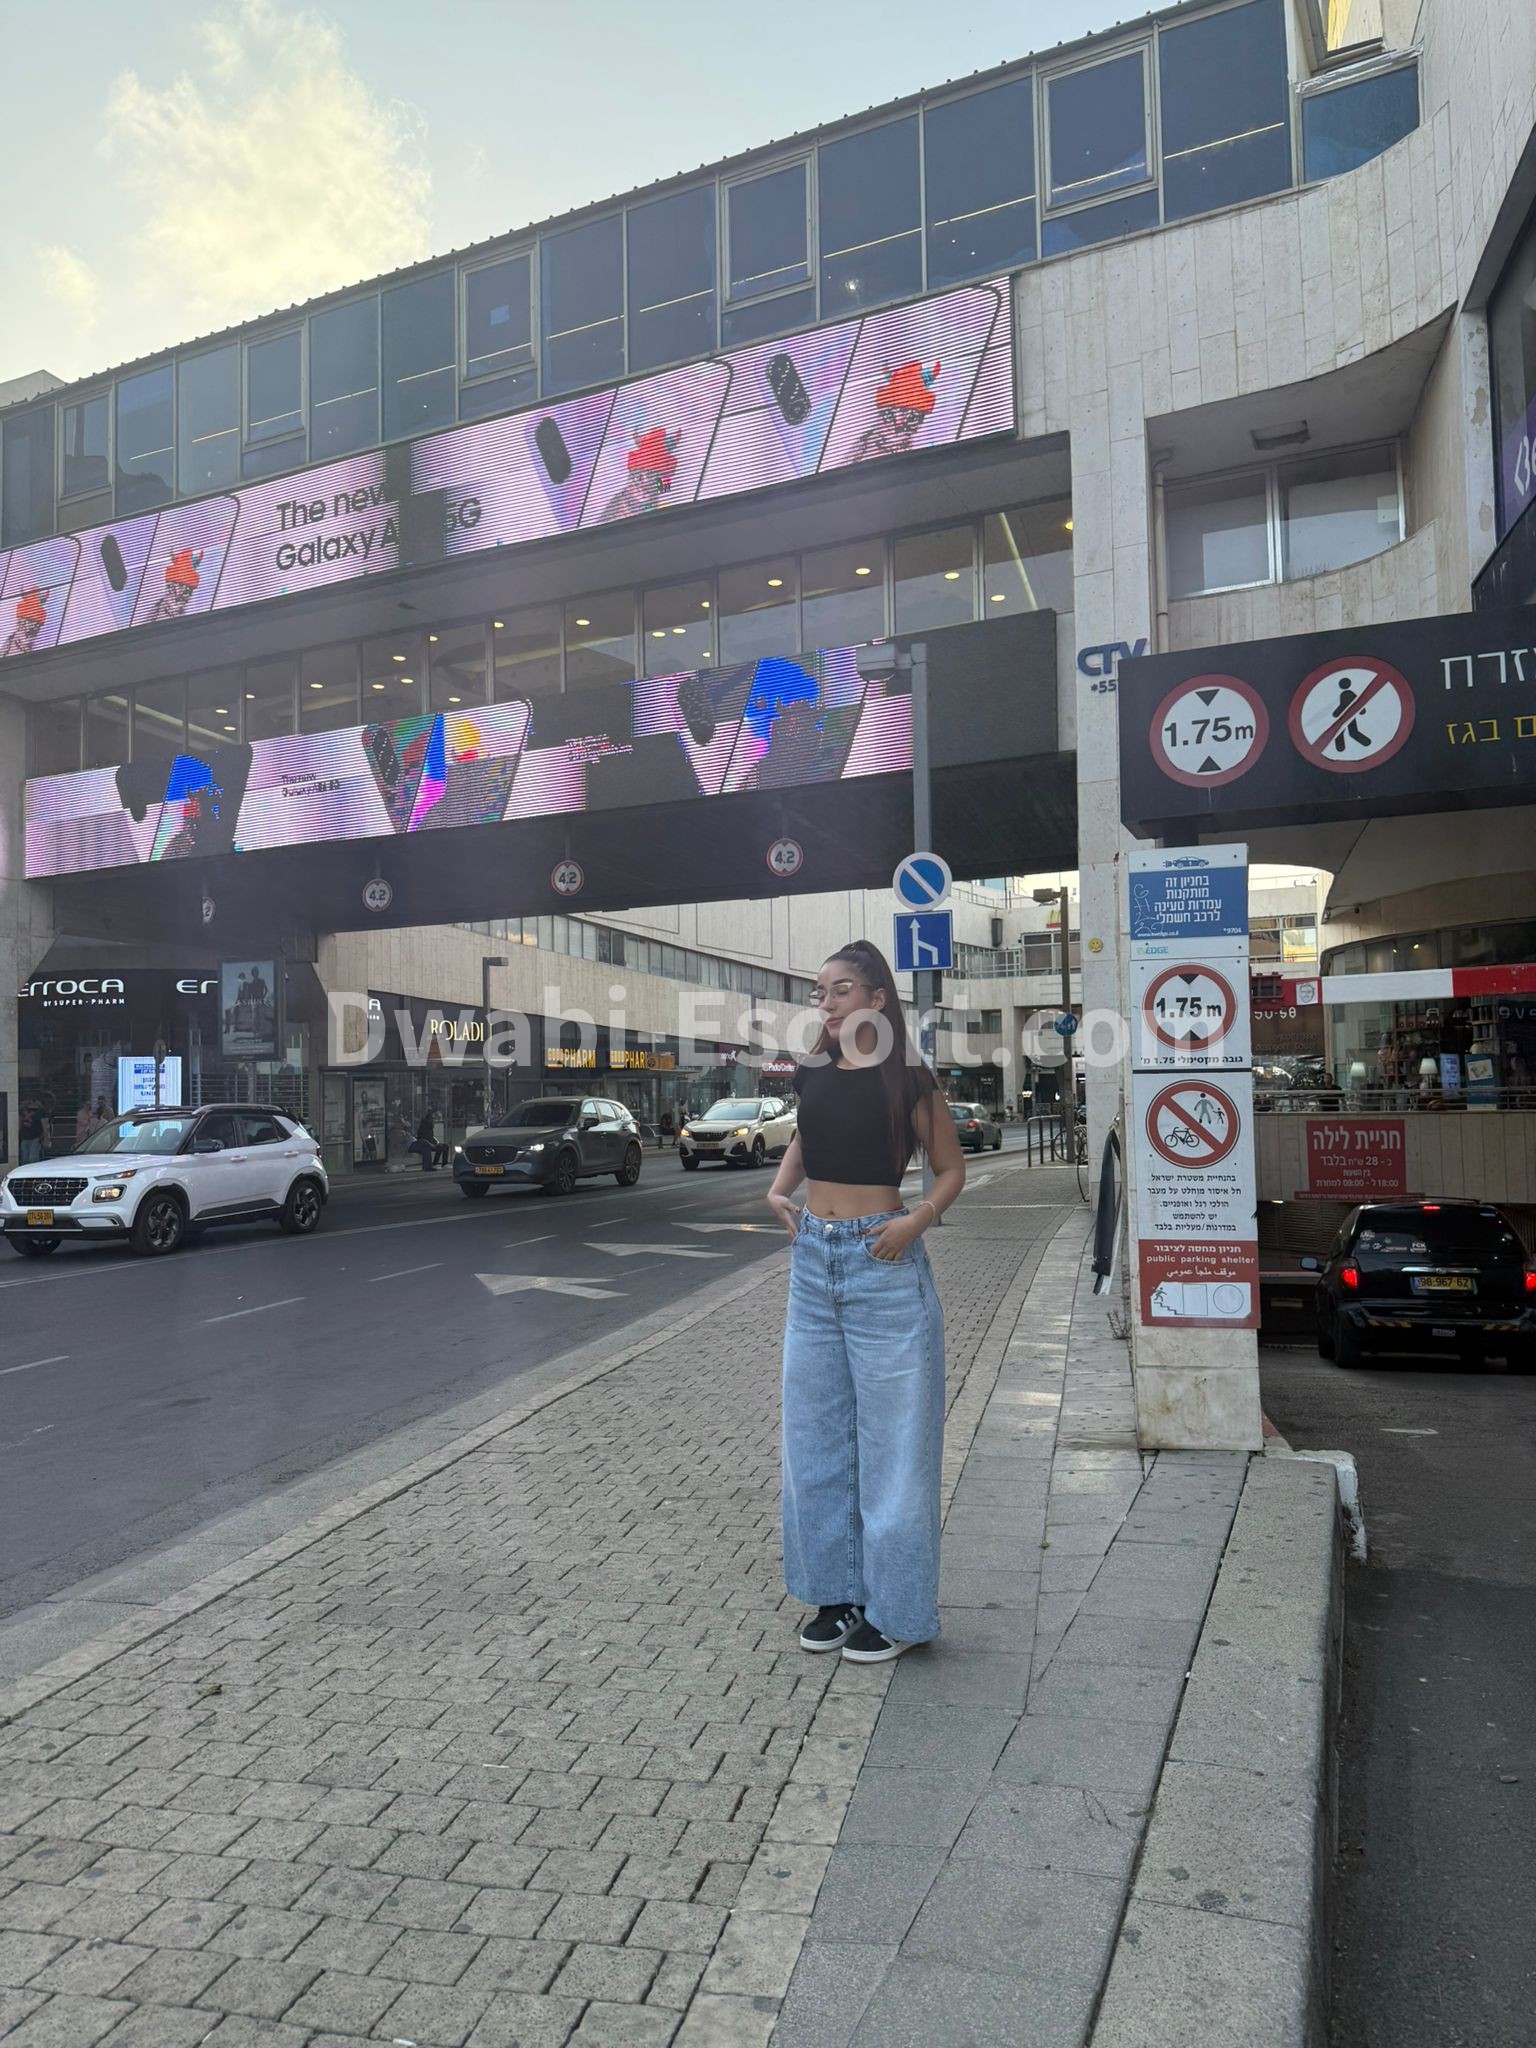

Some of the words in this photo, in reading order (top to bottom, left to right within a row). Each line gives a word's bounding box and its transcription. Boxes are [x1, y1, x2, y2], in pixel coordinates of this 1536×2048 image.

[276, 500, 326, 531] The
[276, 528, 375, 571] Galaxy
[1440, 647, 1536, 690] זרח
[1446, 719, 1501, 745] בגז
[774, 851, 795, 864] 4.2
[558, 872, 577, 884] 4.2
[1165, 877, 1177, 887] זה
[1181, 875, 1210, 888] בחניון
[369, 890, 386, 901] 4.2
[1166, 887, 1210, 900] מותקנות
[1154, 901, 1184, 912] טעינה
[1188, 899, 1222, 911] עמדות
[1156, 912, 1190, 924] חשמלי
[1194, 910, 1221, 922] לרכב
[430, 1019, 493, 1042] ROLADI
[1177, 1056, 1220, 1065] מקסימלי
[1313, 1125, 1350, 1150] לילה
[1355, 1130, 1401, 1149] חניית
[1320, 1154, 1347, 1166] בלבד
[1365, 1156, 1378, 1166] 28
[1151, 1174, 1174, 1182] ישראל
[1177, 1174, 1204, 1182] משטרת
[1207, 1174, 1237, 1182] בהנחיית
[1168, 1187, 1178, 1195] על
[1181, 1187, 1205, 1195] מוחלט
[1231, 1187, 1242, 1195] חל
[1172, 1212, 1205, 1220] להשתמש
[1155, 1222, 1173, 1231] בלבד
[1153, 1244, 1185, 1252] לציבור
[1188, 1245, 1216, 1253] מחסה
[1219, 1245, 1241, 1254] חניון
[1146, 1254, 1176, 1263] public
[1181, 1255, 1217, 1264] parking
[1221, 1256, 1255, 1264] shelter
[1166, 1269, 1193, 1278] عمومي
[1195, 1265, 1212, 1277] ملجأ
[1213, 1267, 1237, 1278] موقف
